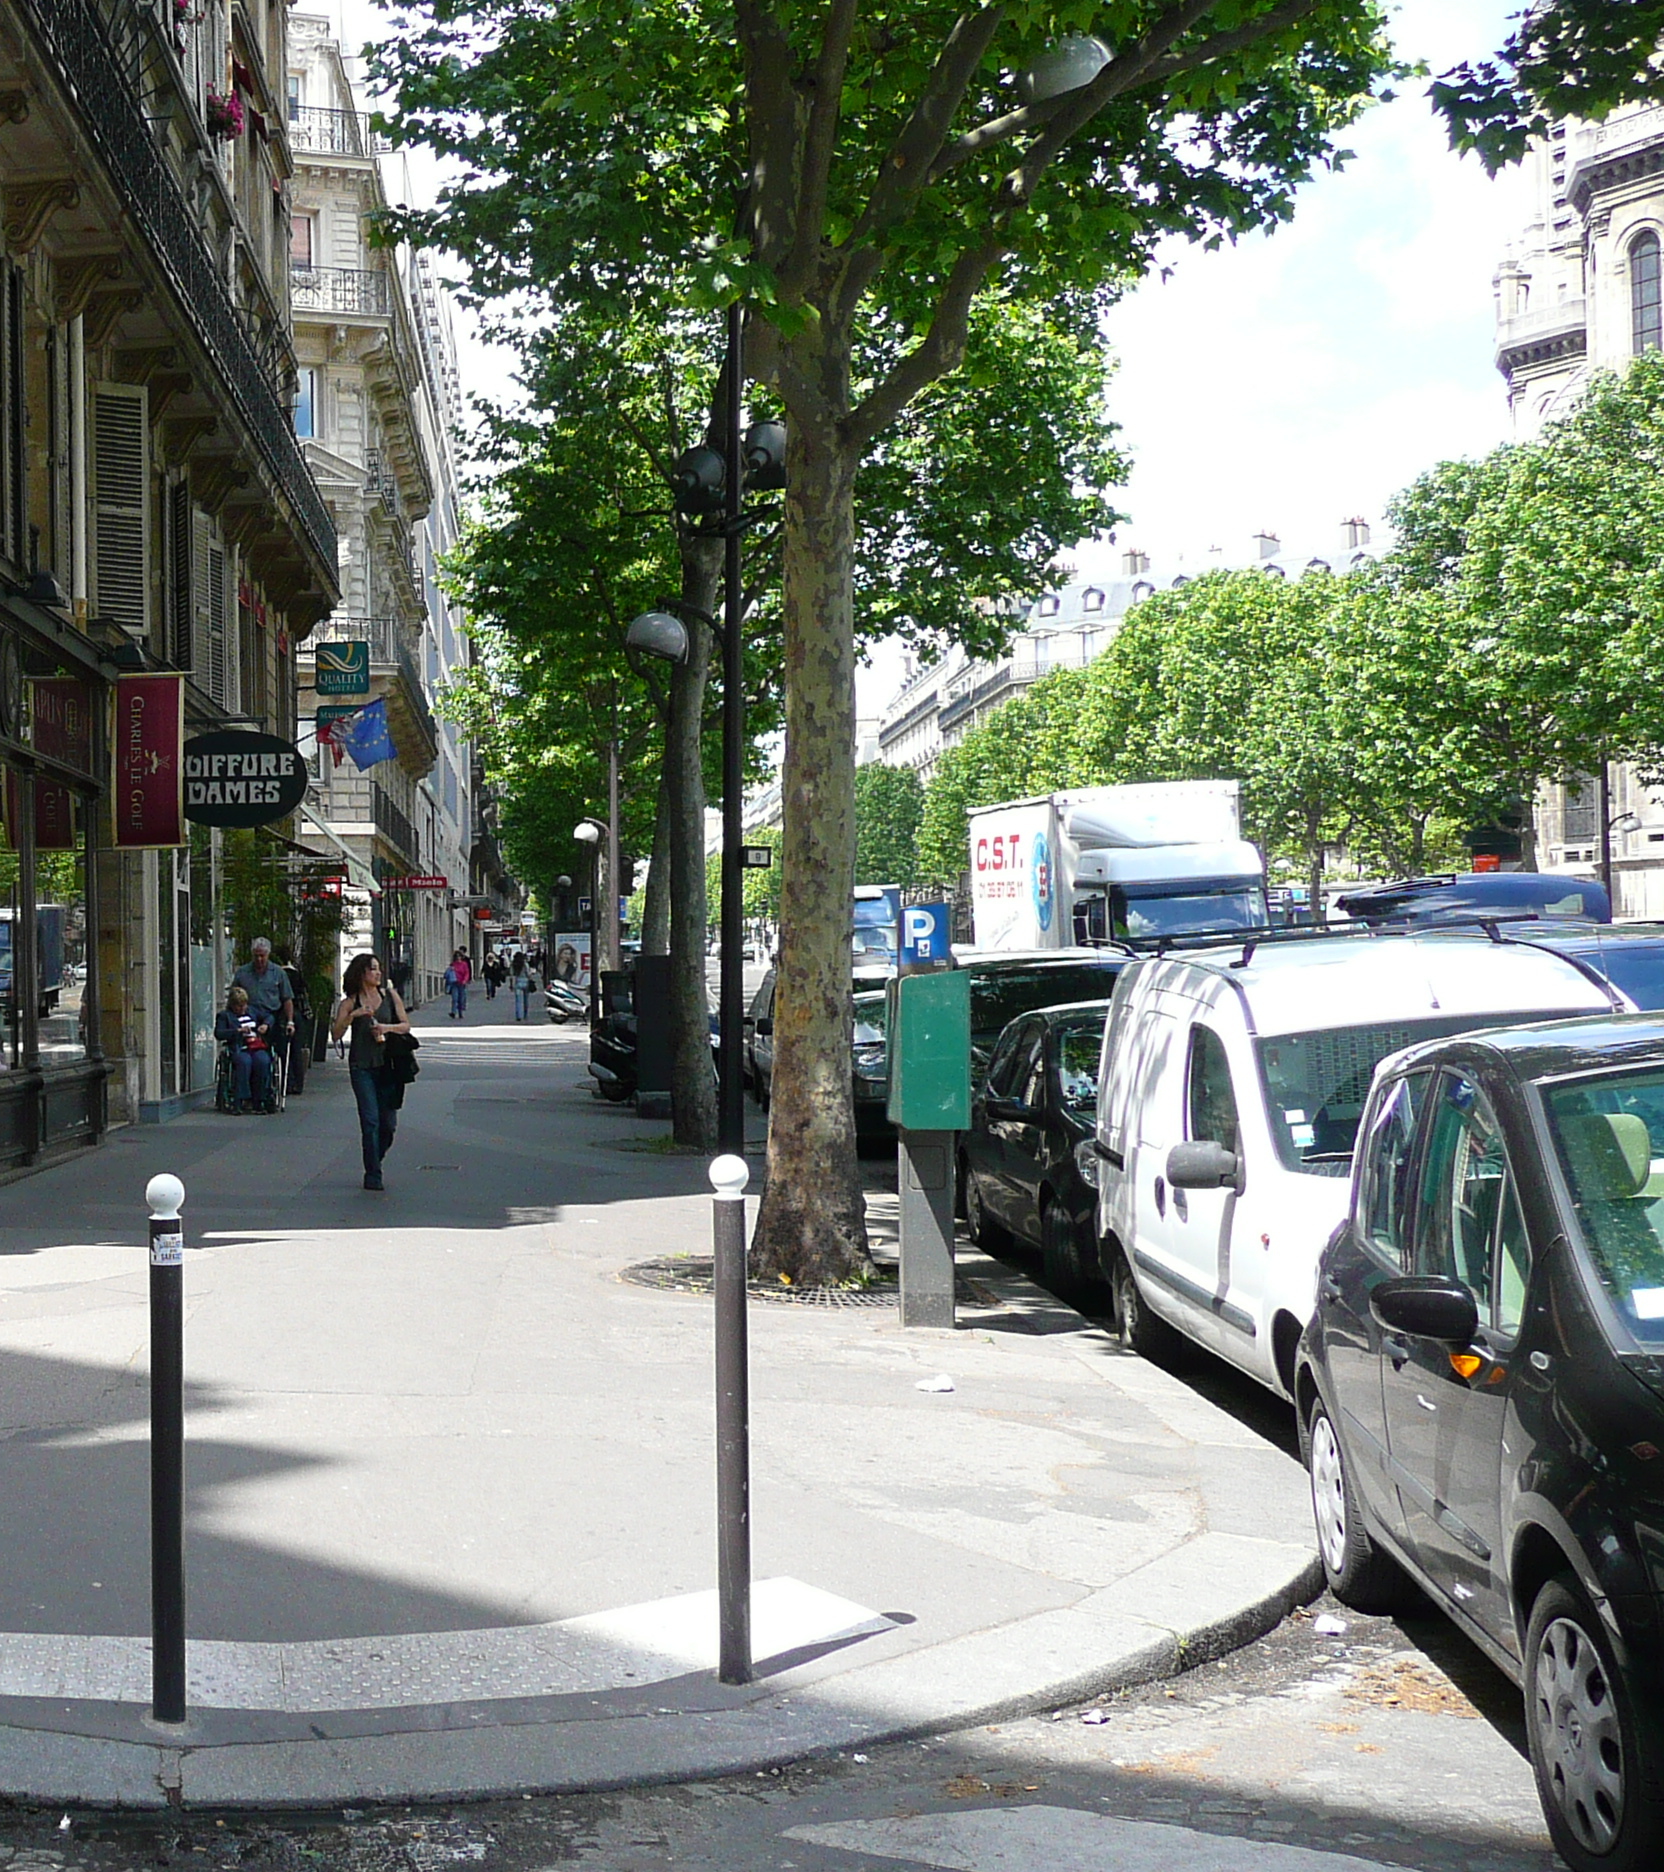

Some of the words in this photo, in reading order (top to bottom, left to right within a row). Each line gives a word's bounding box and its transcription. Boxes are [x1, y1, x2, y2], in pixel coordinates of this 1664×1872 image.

[319, 674, 364, 686] QUALITY
[130, 696, 144, 763] CHARLES
[185, 753, 295, 777] OIFFURE
[130, 789, 145, 831] GOLF
[187, 781, 281, 804] DAMES
[976, 834, 1024, 871] C.S.T.
[904, 909, 936, 948] P
